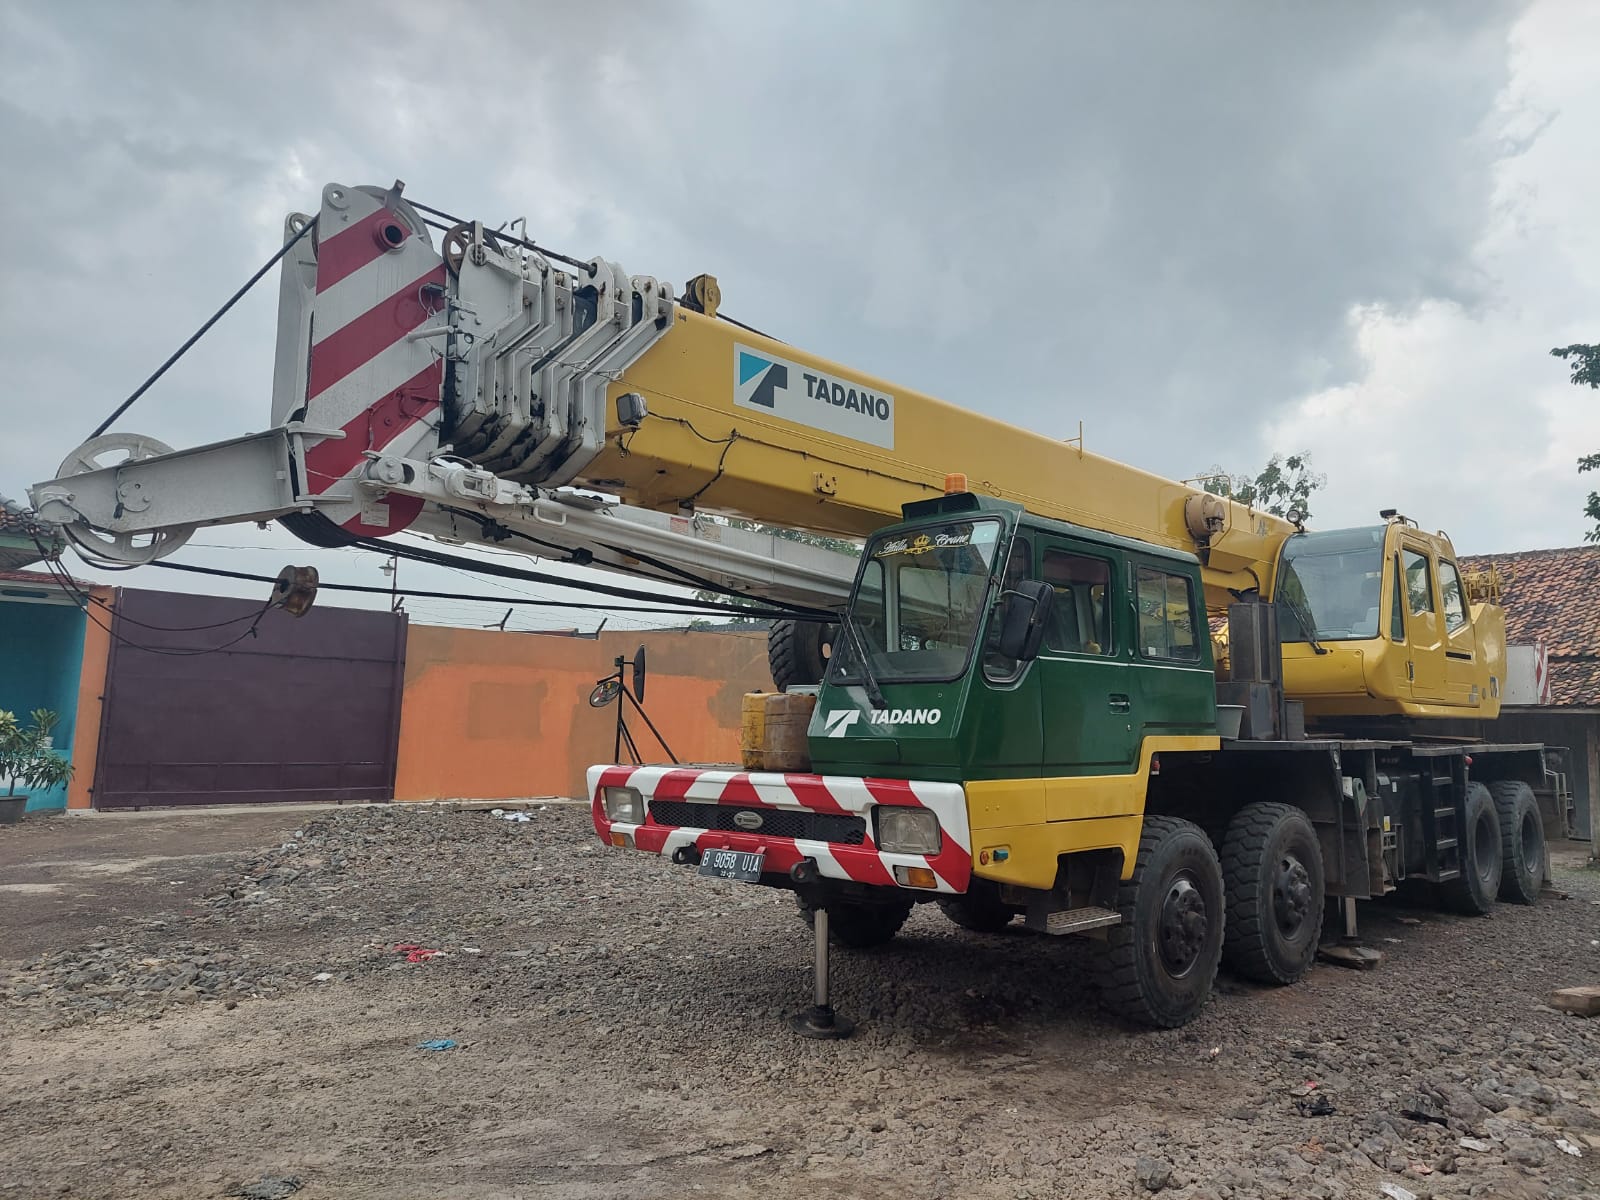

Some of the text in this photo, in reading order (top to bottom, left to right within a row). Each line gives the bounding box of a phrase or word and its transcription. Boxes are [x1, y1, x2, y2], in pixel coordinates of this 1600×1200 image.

[803, 373, 890, 421] TADANO
[870, 709, 942, 725] TADANO
[702, 851, 760, 873] B 9058 UIA
